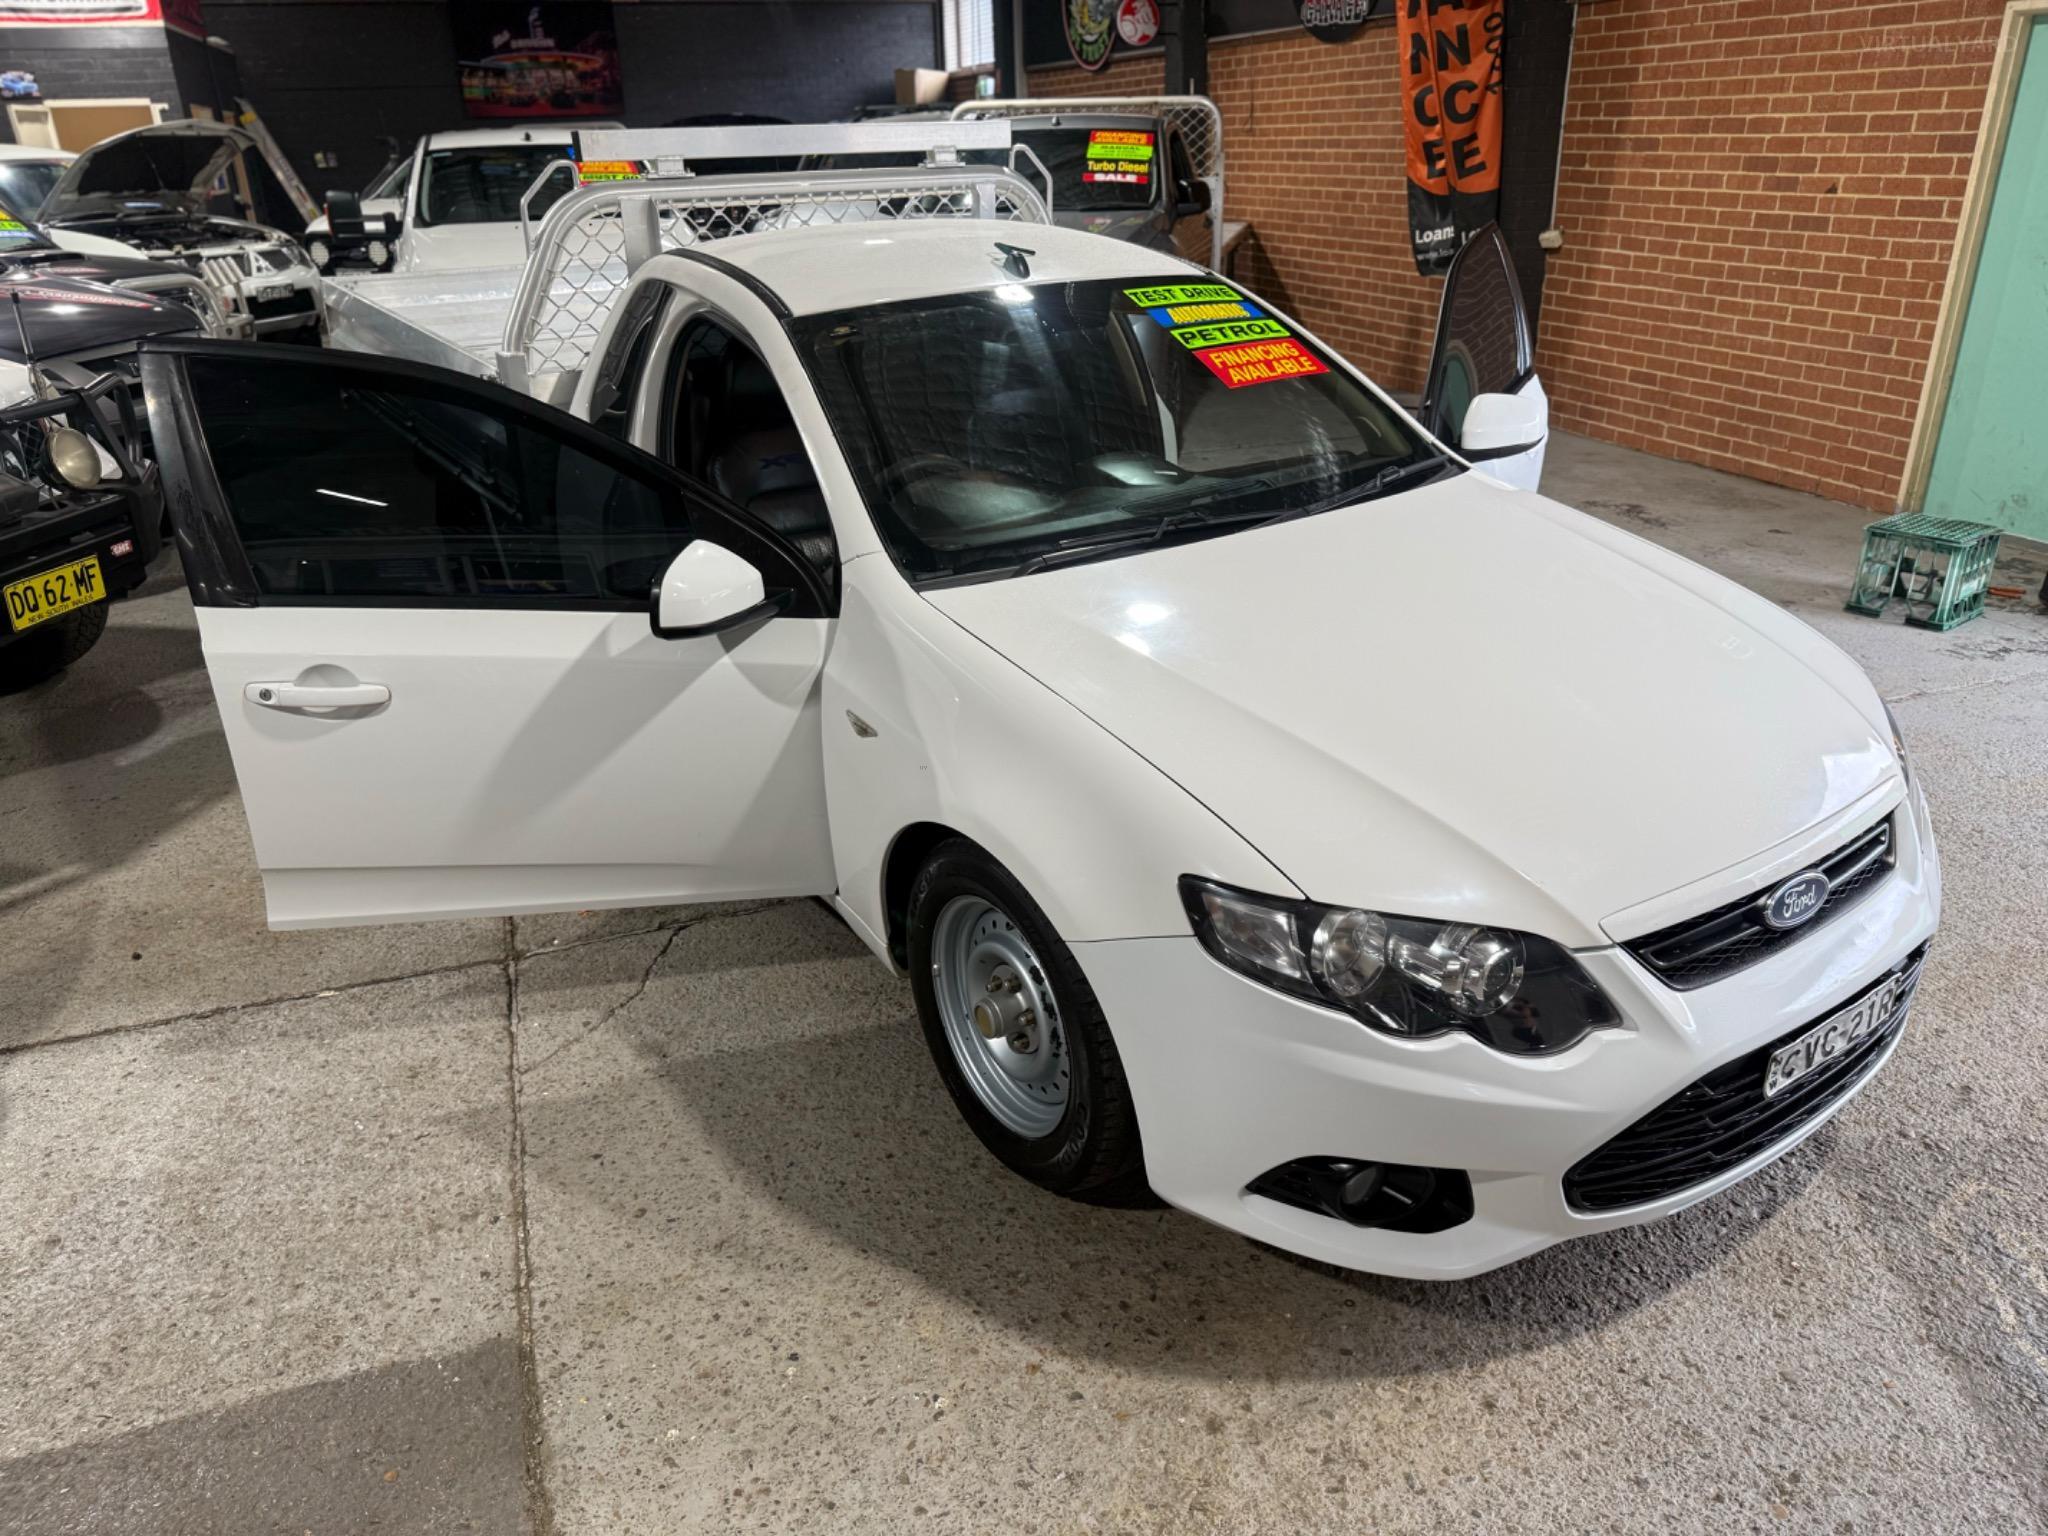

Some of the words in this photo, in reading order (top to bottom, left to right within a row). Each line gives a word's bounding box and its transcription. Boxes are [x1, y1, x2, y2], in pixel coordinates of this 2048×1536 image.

[1088, 161, 1116, 171] Turbo
[1118, 161, 1149, 173] Diesel
[1093, 173, 1137, 182] SALE
[1130, 288, 1177, 304] TEST
[1179, 285, 1236, 301] DRIVE
[1167, 303, 1250, 324] AUTOMATIC
[1180, 321, 1282, 346] PETROL
[1209, 342, 1299, 369] FINANCING
[1228, 356, 1317, 384] AVAILABLE
[1783, 883, 1816, 918] Ford
